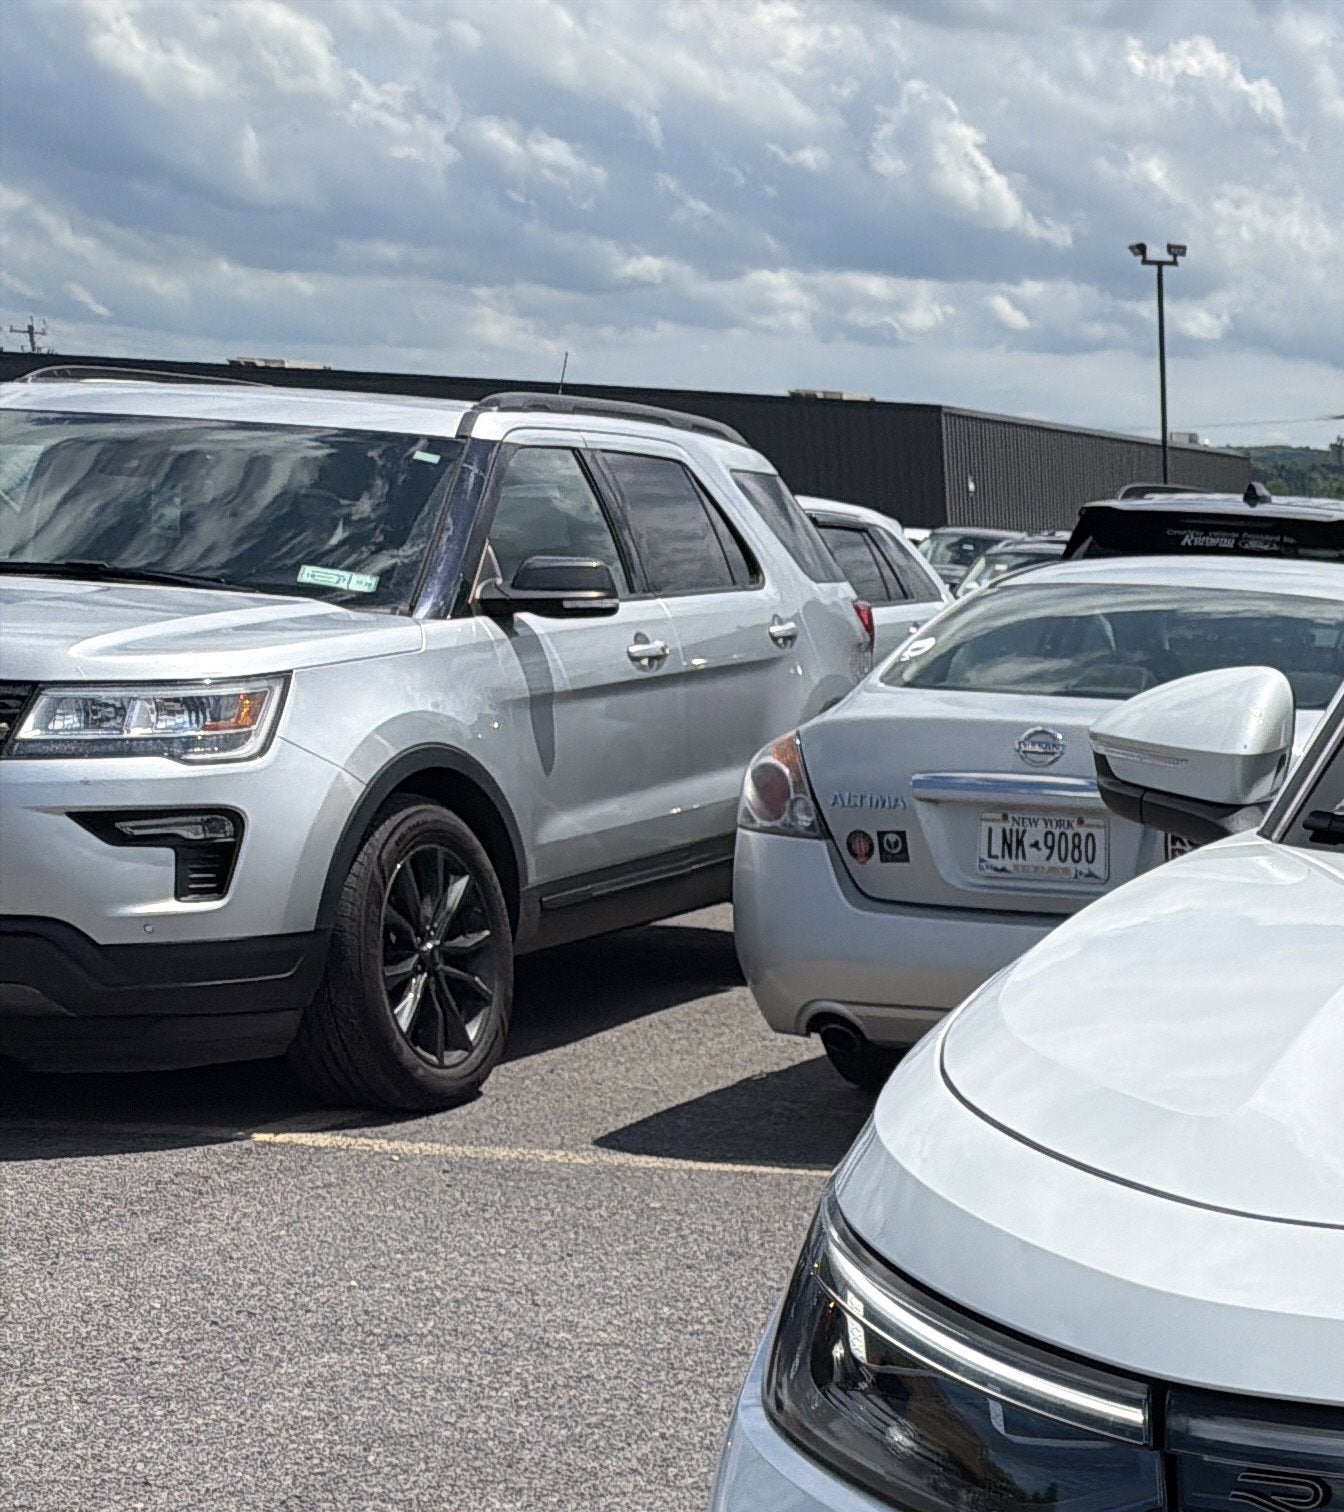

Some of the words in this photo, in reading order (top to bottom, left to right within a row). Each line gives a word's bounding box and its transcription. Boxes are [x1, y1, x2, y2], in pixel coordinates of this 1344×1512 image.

[831, 792, 907, 810] ALTIMA
[1010, 815, 1042, 829] NEW
[1043, 818, 1076, 831] YORK
[987, 826, 1027, 862] LNK
[1043, 831, 1097, 864] 9080
